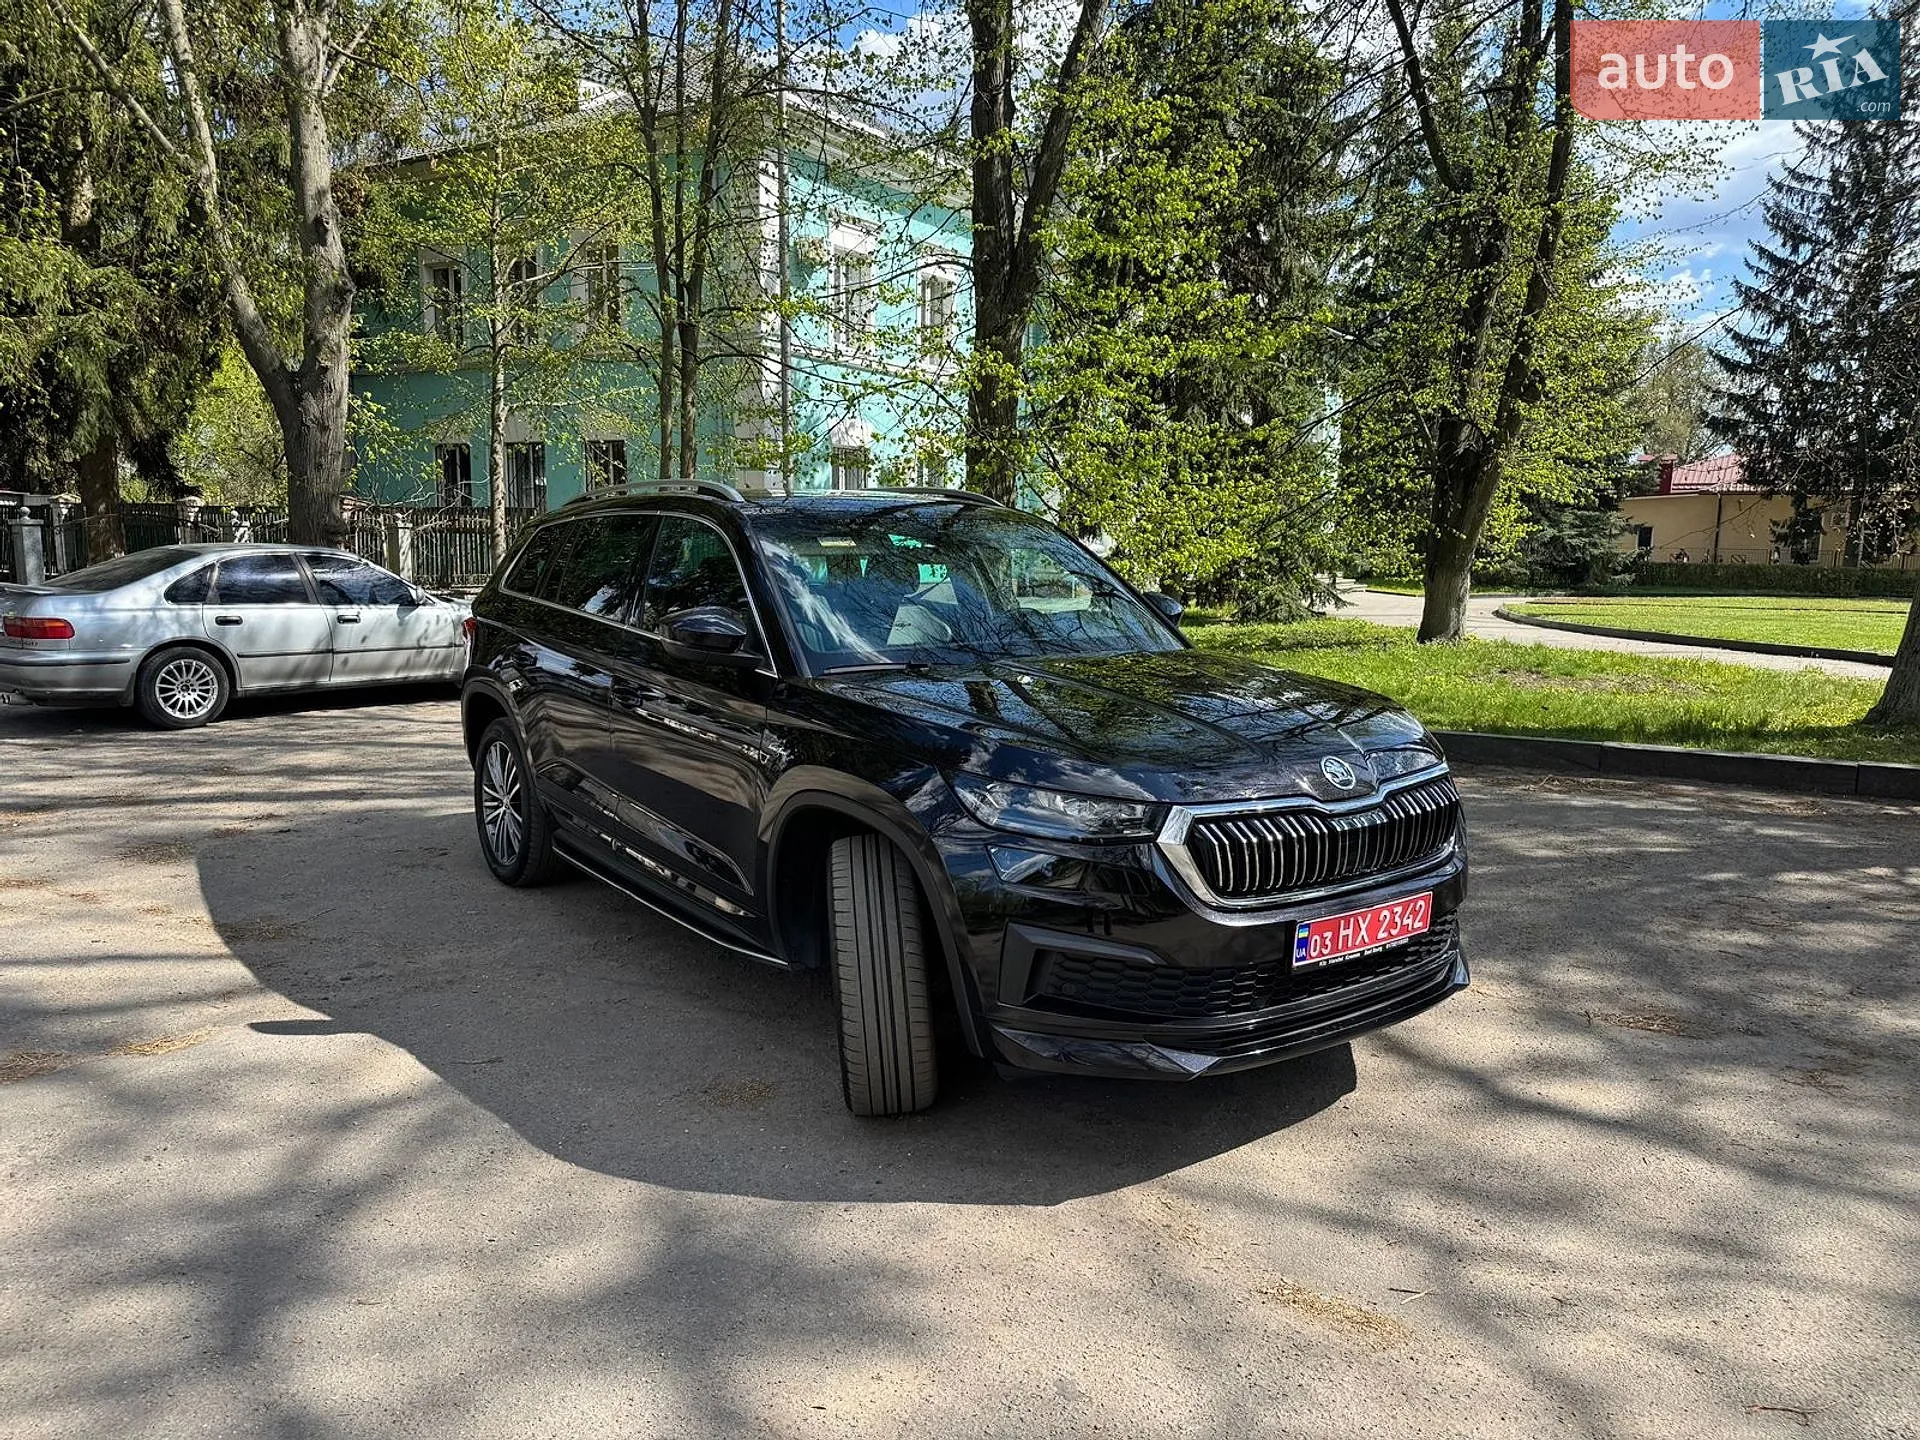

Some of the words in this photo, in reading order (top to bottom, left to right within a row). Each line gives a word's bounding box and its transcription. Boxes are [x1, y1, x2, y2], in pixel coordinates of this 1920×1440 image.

[1310, 931, 1333, 957] 03
[1338, 913, 1371, 949] HX
[1377, 900, 1425, 940] 2342
[1296, 948, 1306, 958] UA
